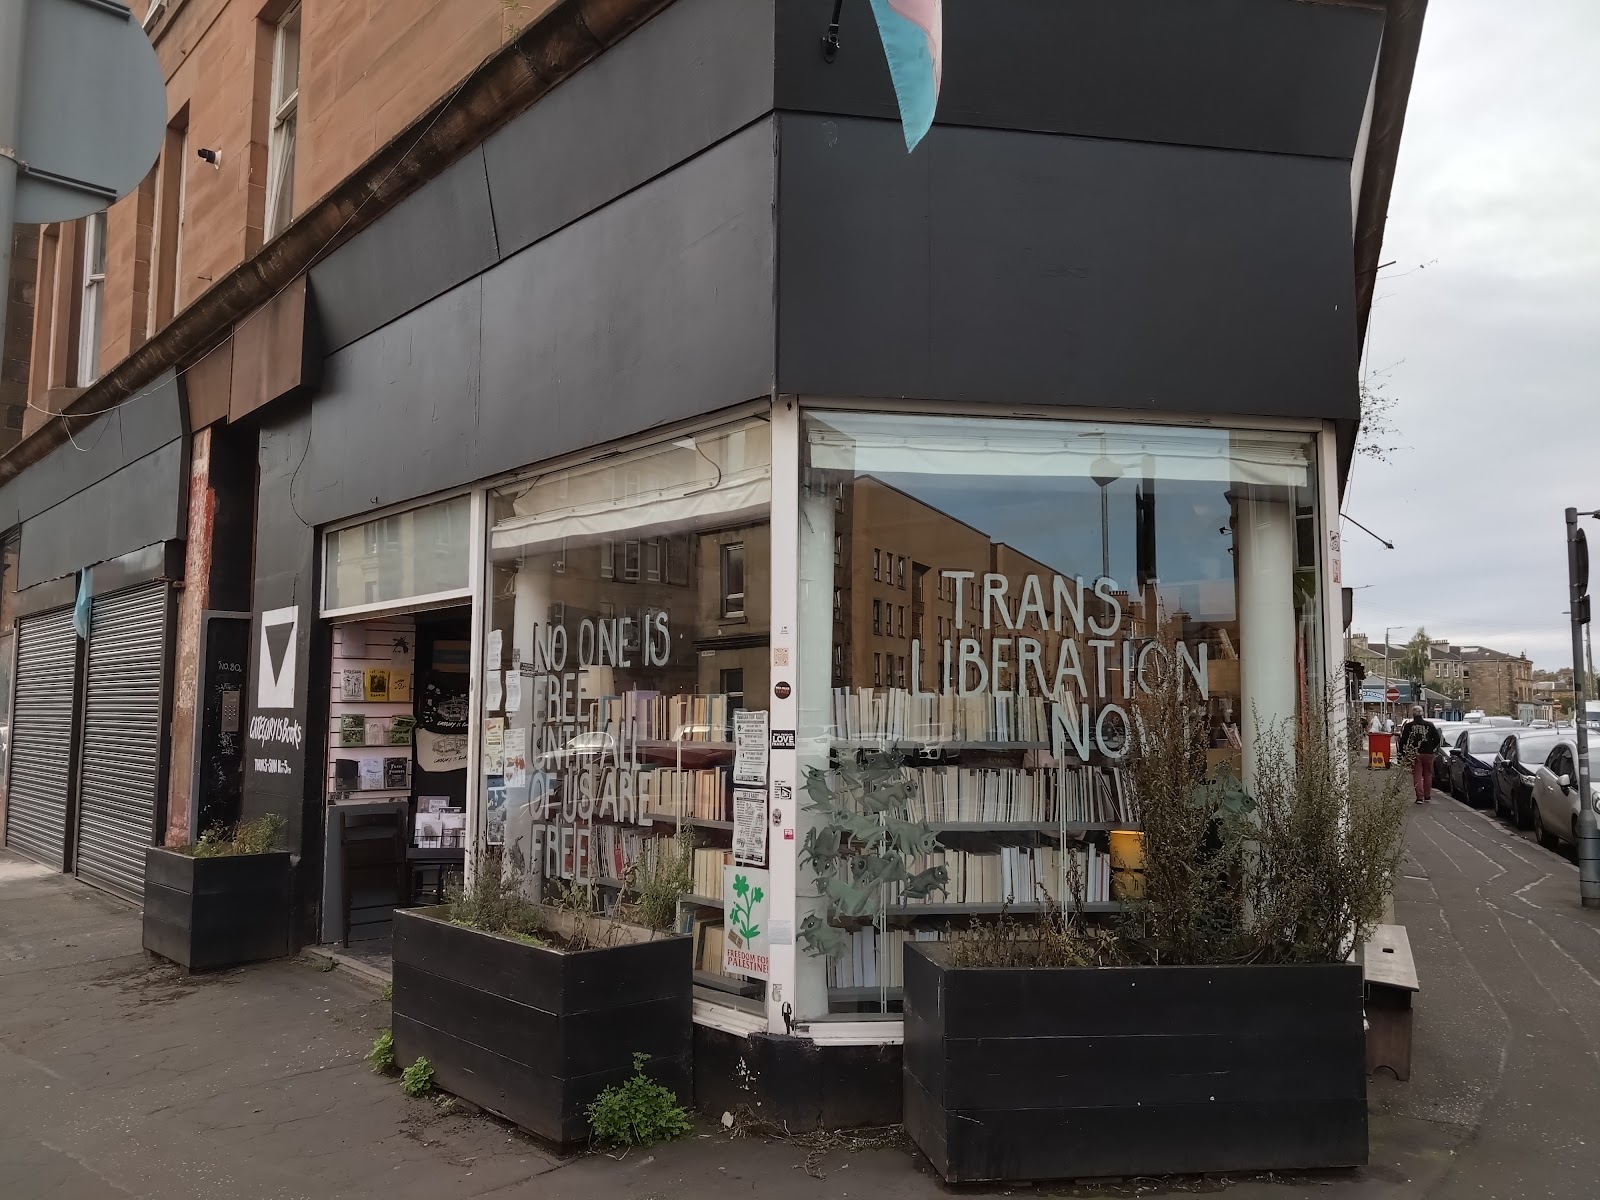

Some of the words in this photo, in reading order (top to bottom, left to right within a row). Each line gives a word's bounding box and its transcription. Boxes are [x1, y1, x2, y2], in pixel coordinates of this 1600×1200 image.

[942, 571, 1122, 636] TRANS
[534, 623, 568, 671] NO
[578, 618, 631, 668] ONE
[644, 611, 671, 666] IS
[911, 638, 1209, 700] LIBERATION
[535, 671, 590, 723] FREE
[600, 721, 642, 771] ALL
[772, 735, 794, 743] LOVE
[530, 771, 557, 820] OF
[563, 770, 594, 823] US
[599, 770, 654, 826] ARE
[530, 823, 592, 885] FREE
[727, 949, 756, 962] FREEDOM
[727, 957, 769, 974] PALESTINE!
